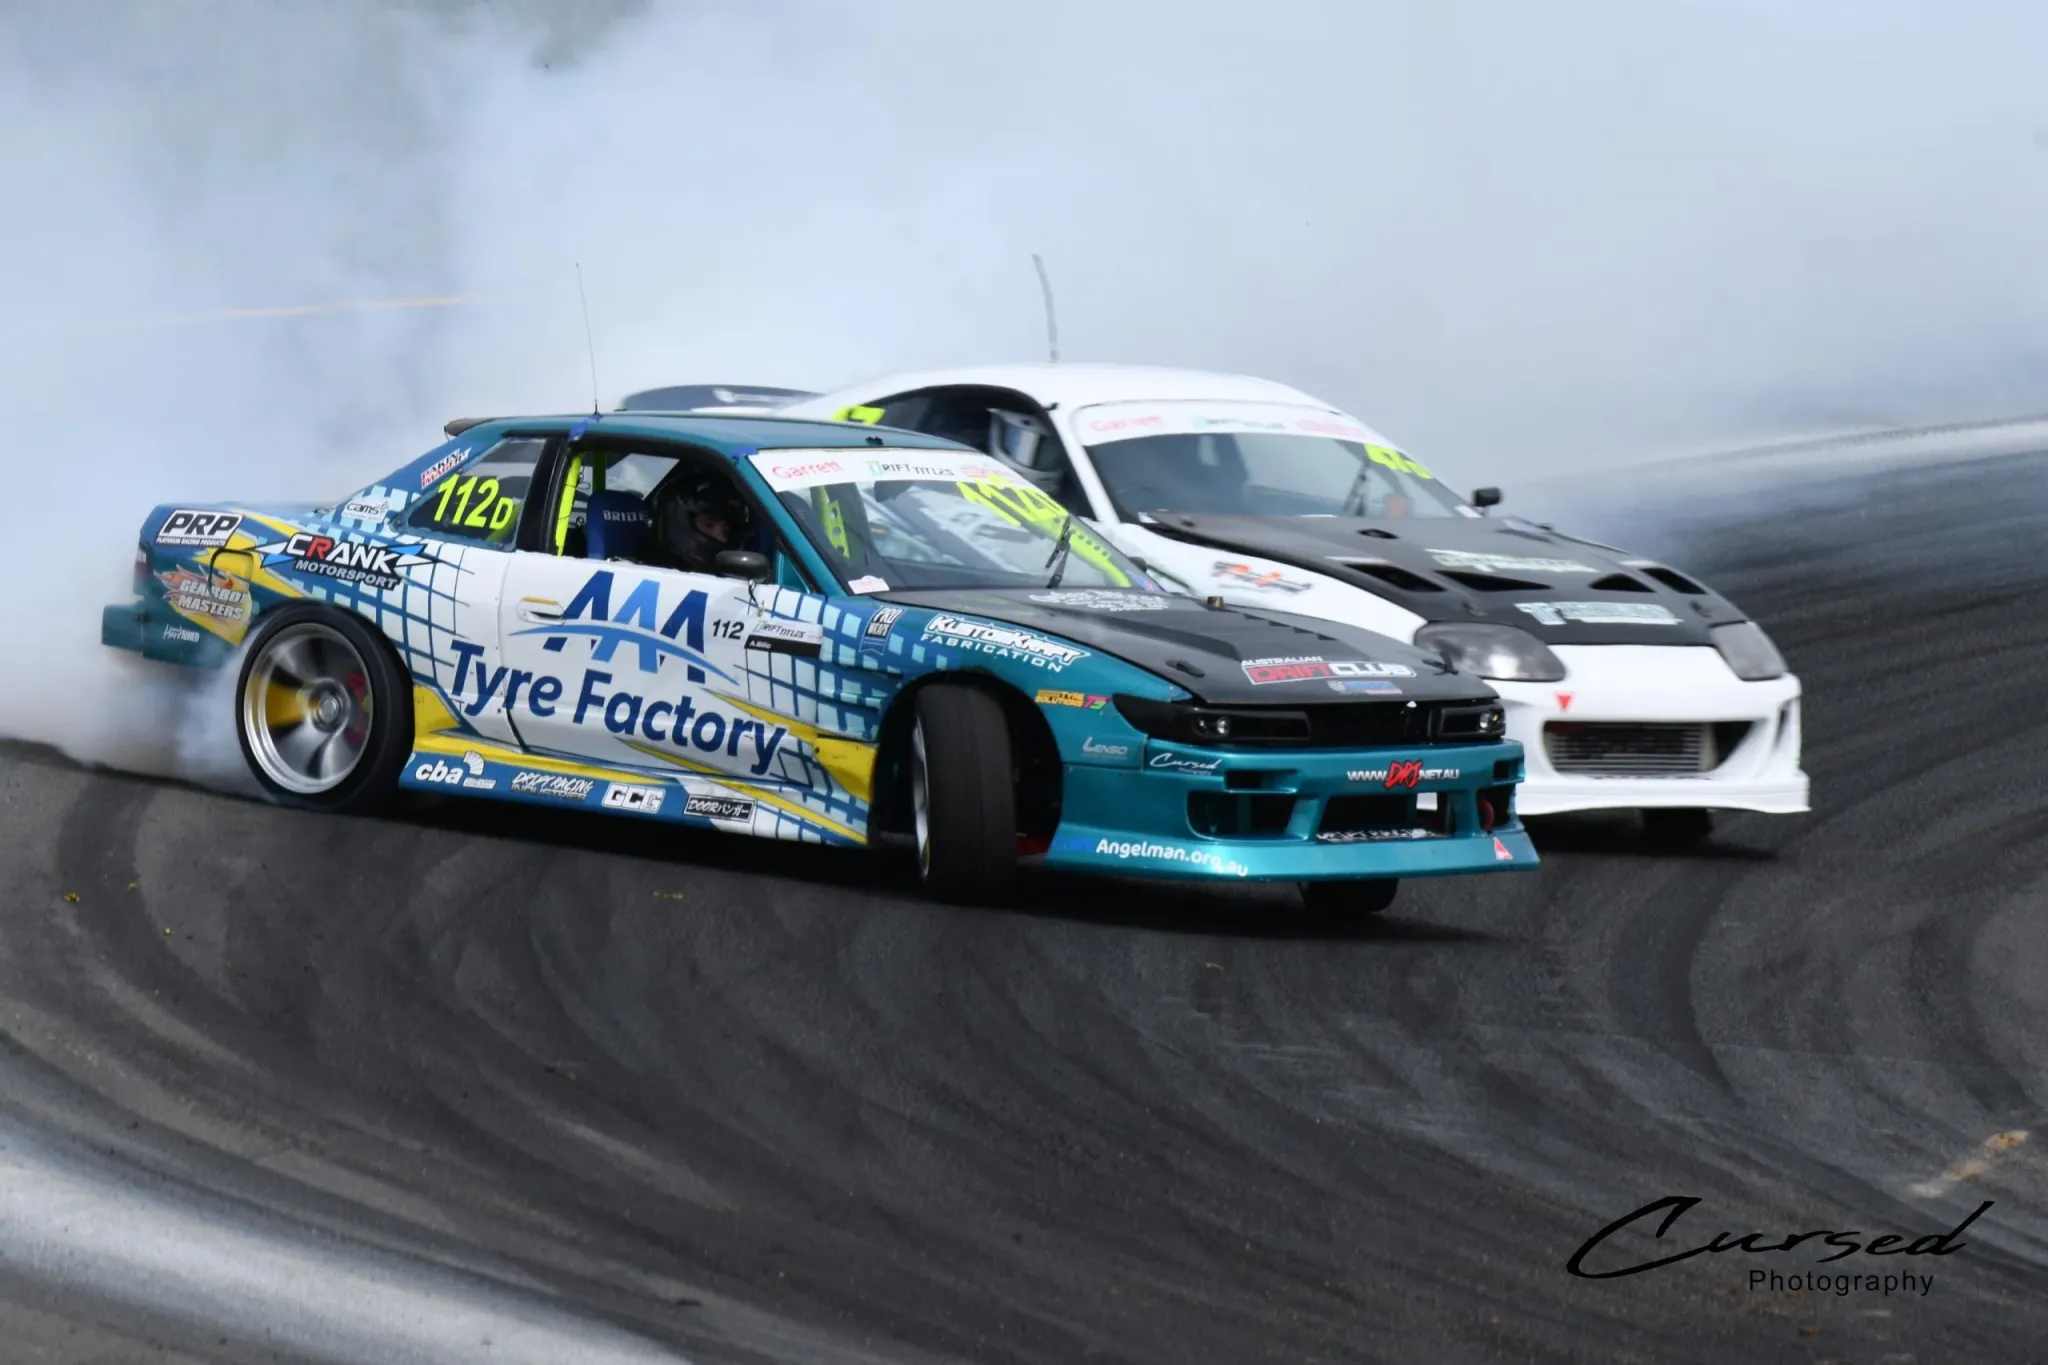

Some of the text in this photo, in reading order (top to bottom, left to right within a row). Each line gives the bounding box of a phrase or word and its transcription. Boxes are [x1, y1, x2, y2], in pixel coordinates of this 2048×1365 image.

[772, 459, 844, 480] Garrett
[866, 460, 911, 477] DRIFT
[347, 502, 379, 514] cams
[602, 510, 650, 522] BRIDE
[163, 512, 241, 535] PRP
[287, 533, 398, 574] CRANK
[295, 559, 398, 590] MOTORSPORT
[177, 595, 244, 620] MASTERS
[713, 618, 745, 641] 112
[920, 633, 1063, 673] FABRICATION
[1241, 655, 1324, 667] AUSTRALIAN
[450, 640, 788, 775] Tyre Factory
[415, 760, 464, 785] cba
[1149, 752, 1222, 770] Cursed
